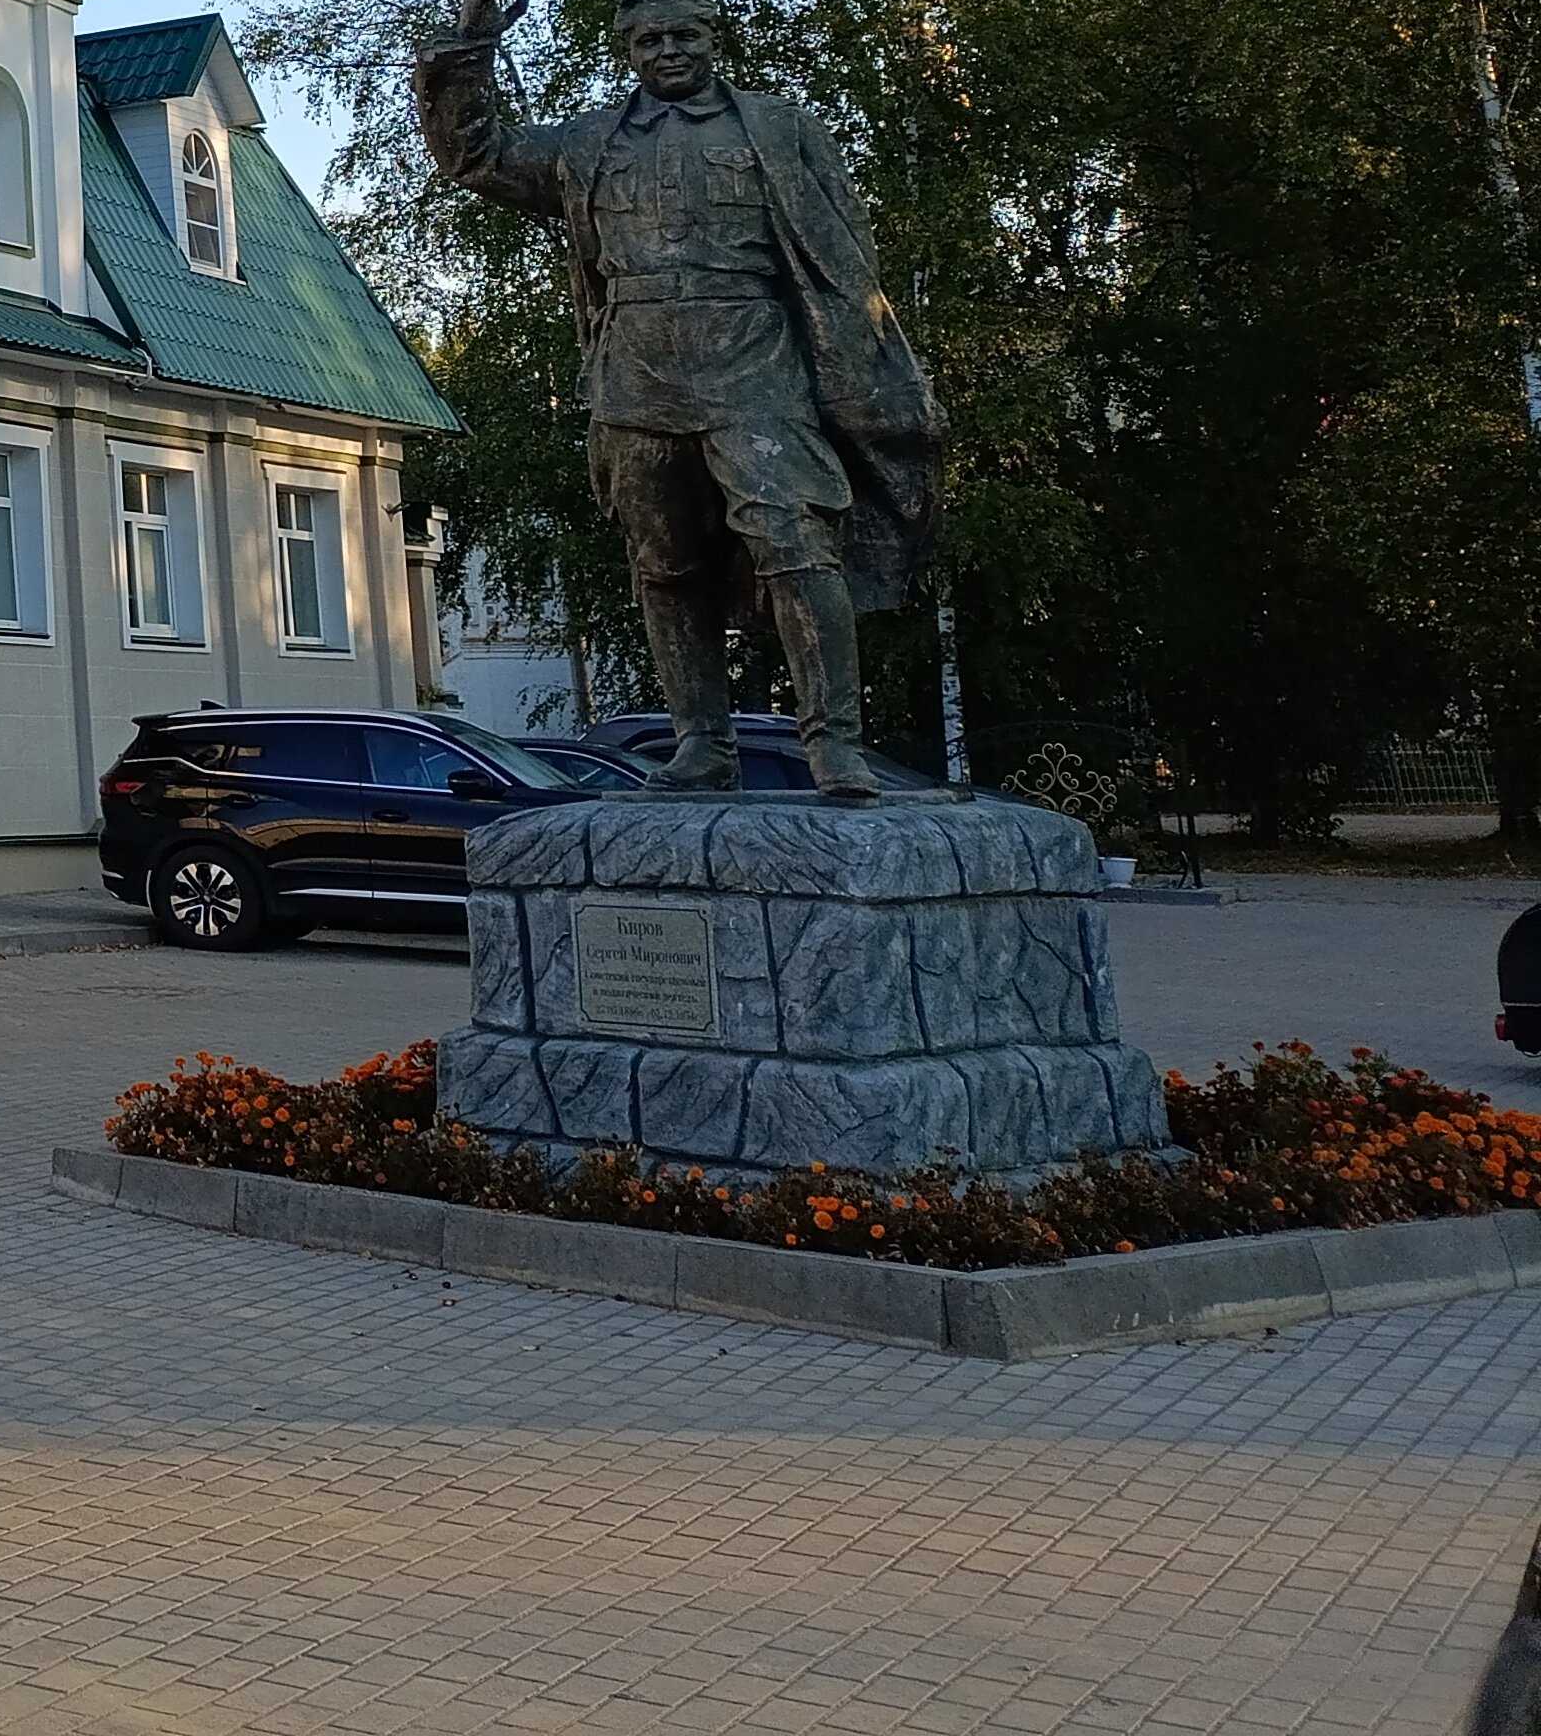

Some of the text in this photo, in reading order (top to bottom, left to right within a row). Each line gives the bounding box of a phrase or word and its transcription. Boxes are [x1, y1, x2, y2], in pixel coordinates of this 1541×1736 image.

[617, 916, 664, 940] Киров
[586, 944, 701, 967] Сергей Миронович
